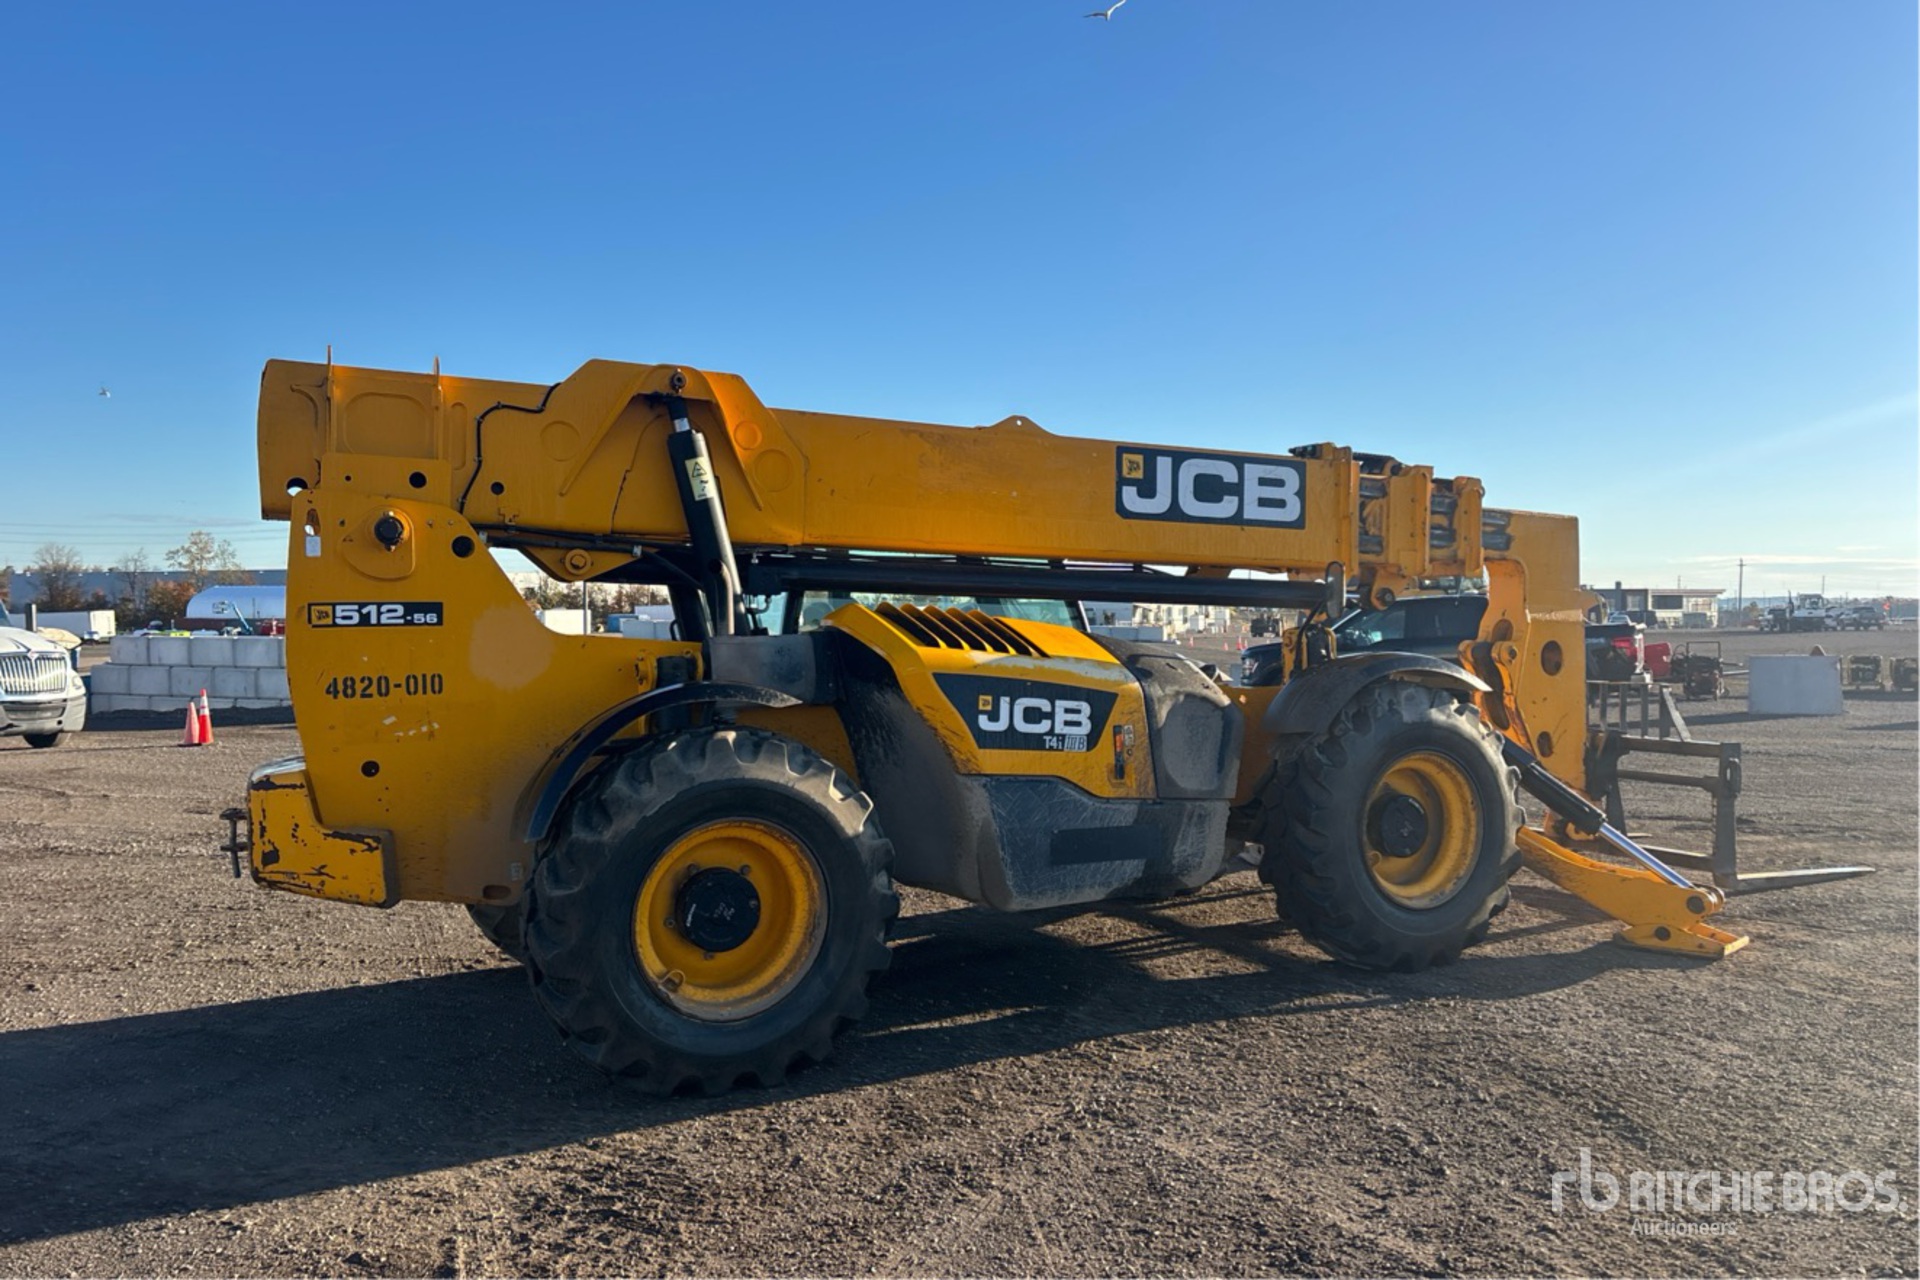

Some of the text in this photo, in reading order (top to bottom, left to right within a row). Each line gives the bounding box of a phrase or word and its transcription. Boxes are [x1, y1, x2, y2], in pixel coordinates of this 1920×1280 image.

[1122, 456, 1301, 522] JCB
[334, 604, 438, 625] 512-56
[325, 673, 444, 699] 4820-010
[978, 696, 1092, 735] JCB
